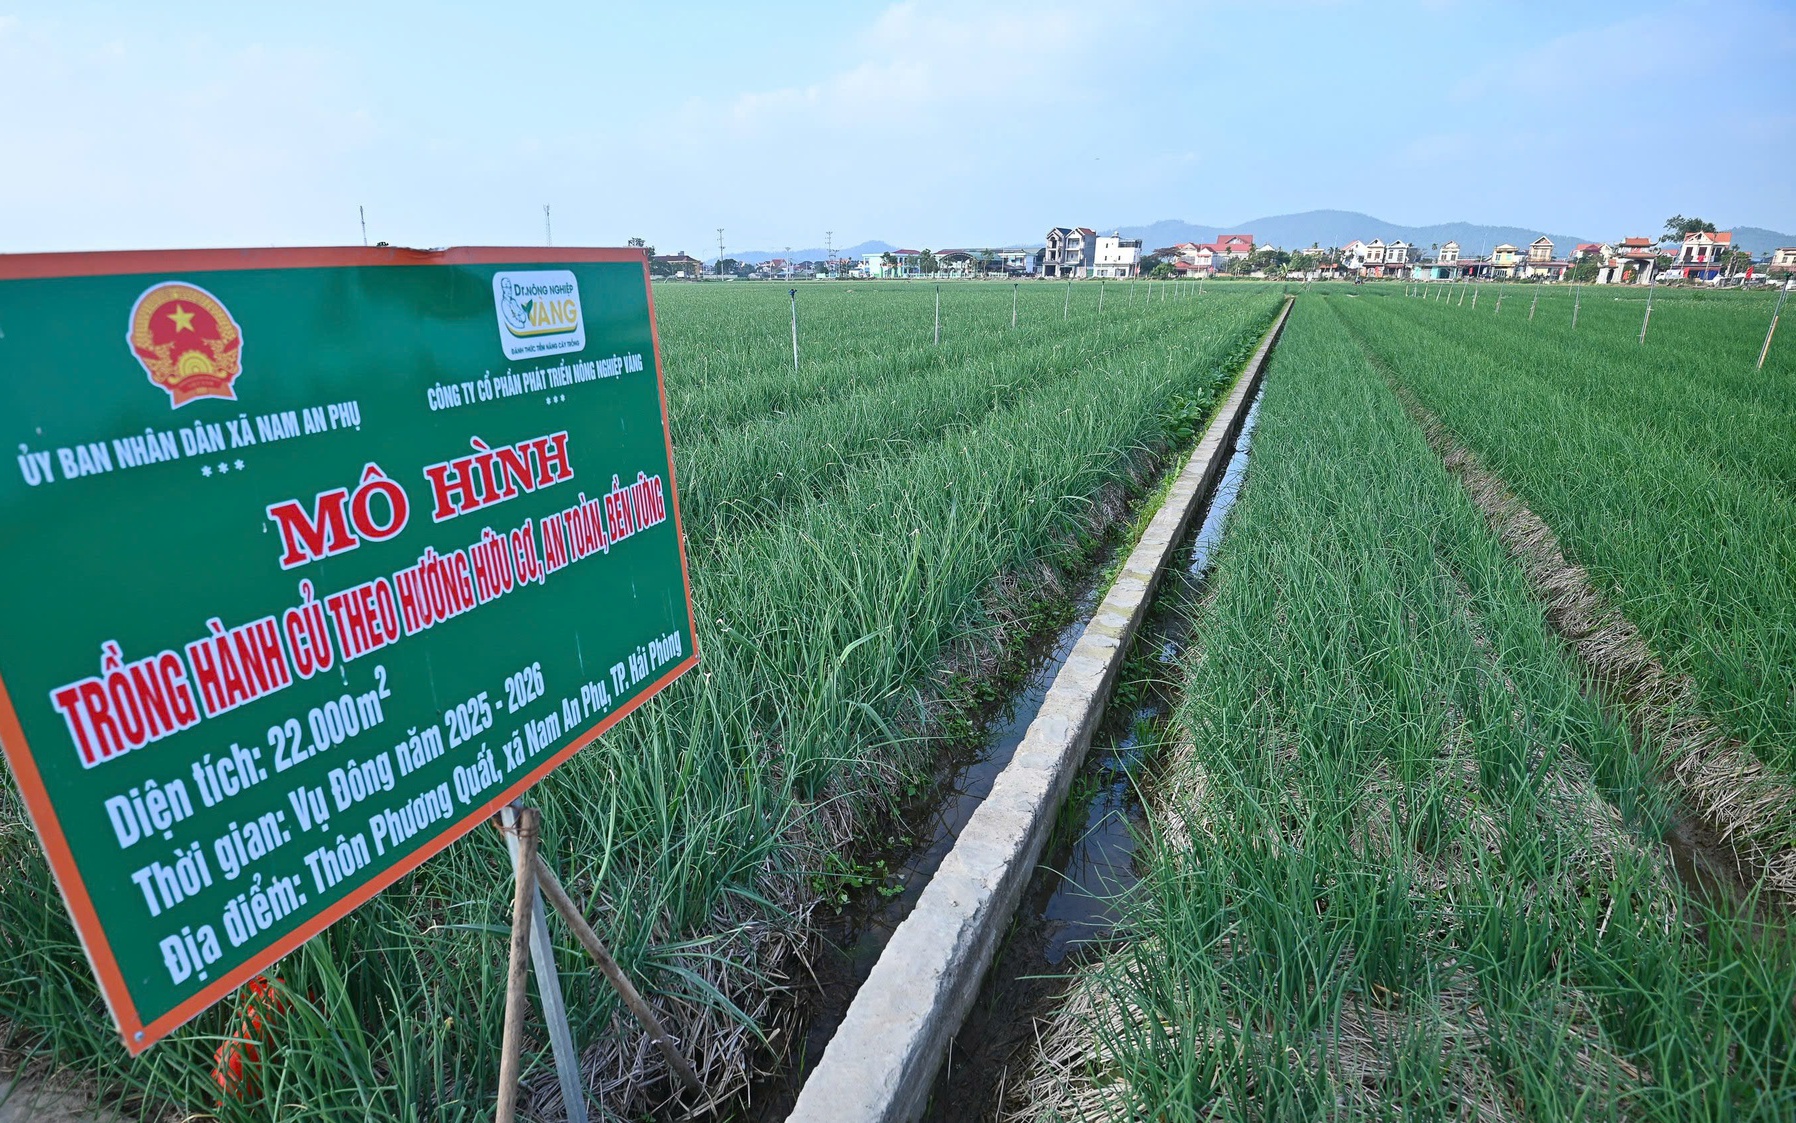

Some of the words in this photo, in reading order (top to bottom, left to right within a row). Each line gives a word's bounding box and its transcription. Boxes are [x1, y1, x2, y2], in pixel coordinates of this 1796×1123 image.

[522, 296, 577, 327] VÀNG
[550, 282, 574, 296] NGHIỆP
[427, 382, 461, 411] CÔNG
[461, 381, 476, 405] TY
[477, 370, 493, 402] CỔ
[493, 368, 522, 399] PHẦN
[522, 366, 546, 393] PHÁT
[547, 358, 573, 388] TRIỂN
[573, 359, 596, 384] NÔNG
[596, 354, 623, 379] NGHIỆP
[623, 351, 644, 374] VÀNG
[17, 443, 54, 486] ỦY
[57, 441, 113, 479] BAN
[112, 427, 179, 469] NHÂN
[179, 420, 227, 457] DÂN
[226, 413, 256, 448] XÃ
[255, 411, 301, 443] NAM
[302, 406, 328, 435] AN
[327, 400, 361, 431] PHỤ
[266, 462, 410, 571] MÔ
[423, 430, 574, 523] HÌNH
[50, 640, 201, 769] TRỒNG
[185, 618, 293, 718] HÀNH
[283, 578, 335, 679] CỦ
[325, 577, 401, 662] THEO
[392, 546, 477, 636] HƯỚNG
[468, 527, 514, 604] HỮU
[510, 518, 546, 585] CƠ,
[540, 513, 568, 574] AN
[563, 492, 610, 554] TOÀN,
[603, 473, 635, 544] BỀN
[630, 470, 667, 532] VỮNG
[104, 779, 194, 850] Diện
[191, 743, 268, 808] tích:
[131, 841, 213, 918] Thời
[214, 808, 292, 880] gian:
[288, 785, 330, 832] Vụ
[327, 760, 395, 813] Đông
[395, 726, 445, 777] năm
[444, 691, 493, 749] 2025
[504, 661, 545, 715] 2026
[159, 923, 222, 986] Địa
[222, 872, 307, 948] điểm:
[304, 834, 372, 895] Thôn
[369, 782, 454, 857] Phương
[453, 742, 504, 805] Quất,
[502, 730, 526, 774] xã
[524, 711, 562, 757] Nam
[561, 695, 582, 733] An
[581, 680, 612, 713] Phụ,
[609, 661, 630, 696] TP.
[628, 645, 650, 683] Hải
[648, 629, 682, 671] Phòng
